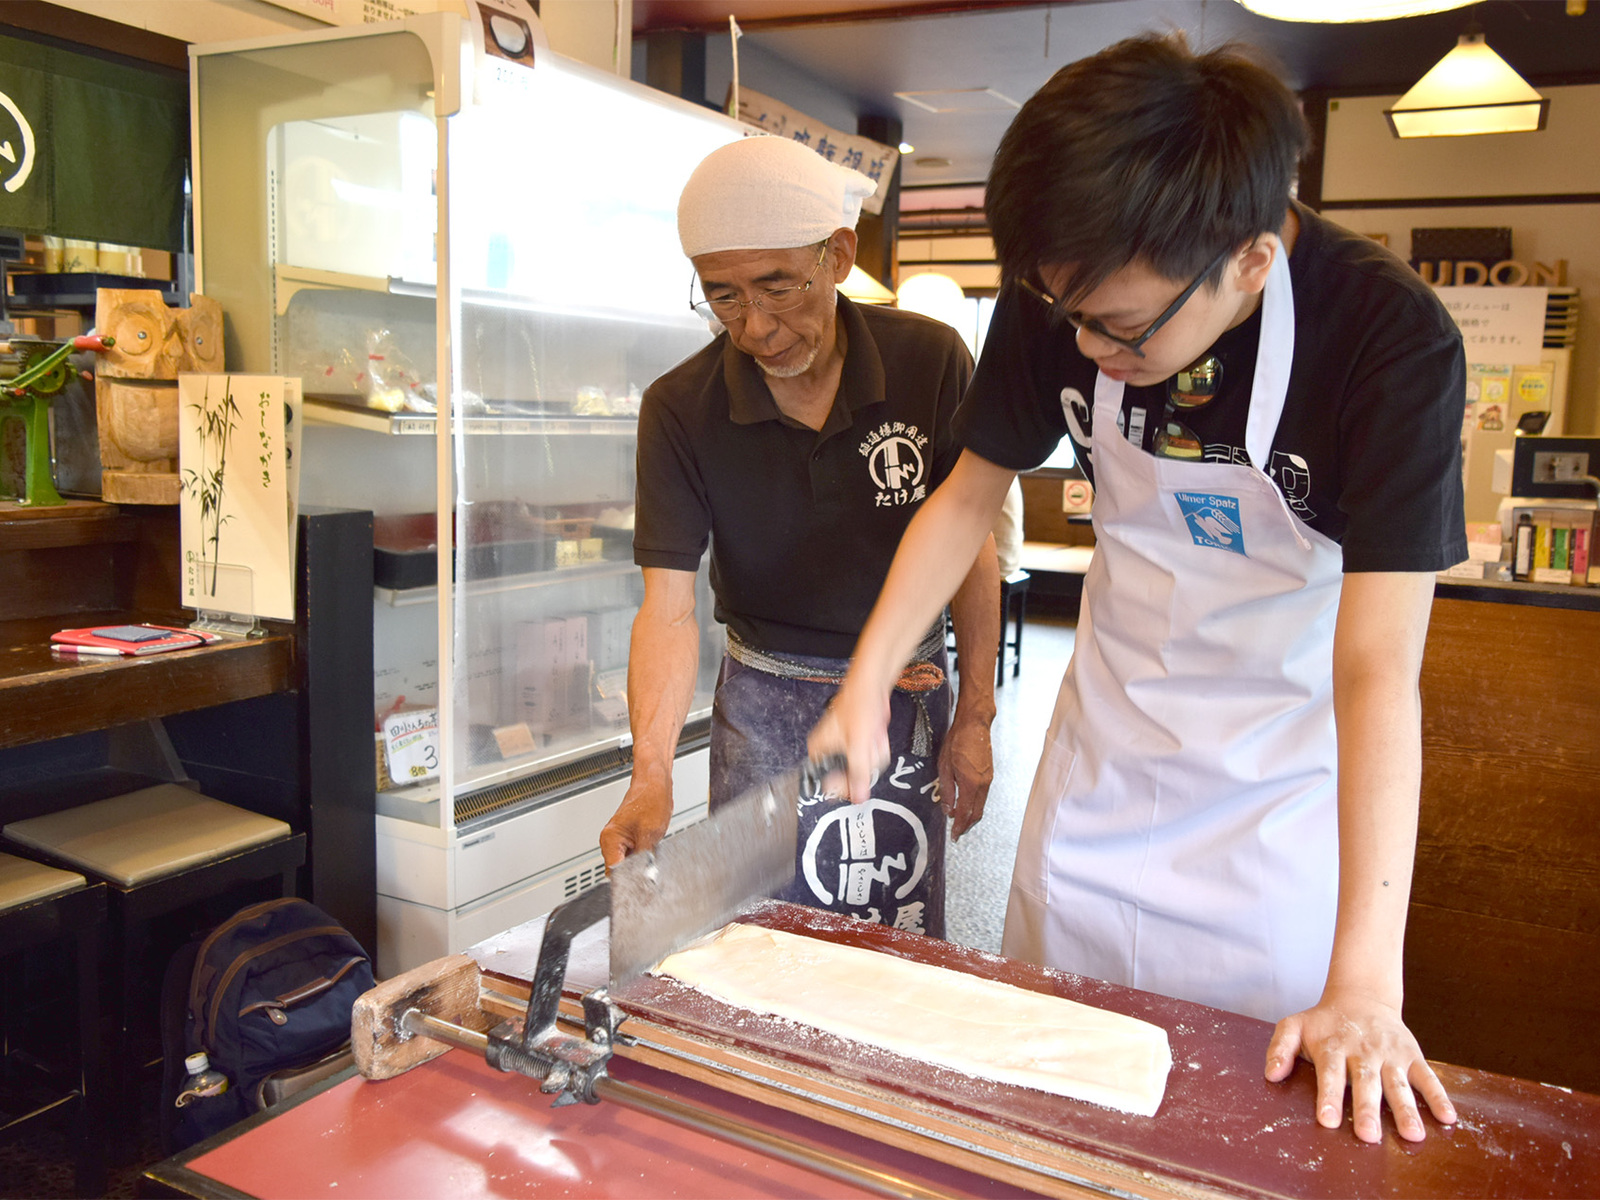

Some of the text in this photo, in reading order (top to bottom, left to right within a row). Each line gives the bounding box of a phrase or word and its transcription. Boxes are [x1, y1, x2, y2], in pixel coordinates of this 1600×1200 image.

[1419, 259, 1569, 287] UDON
[258, 391, 273, 488] おしながき
[875, 484, 926, 507] たけ屋
[1178, 493, 1237, 509] Ulmer Spatz
